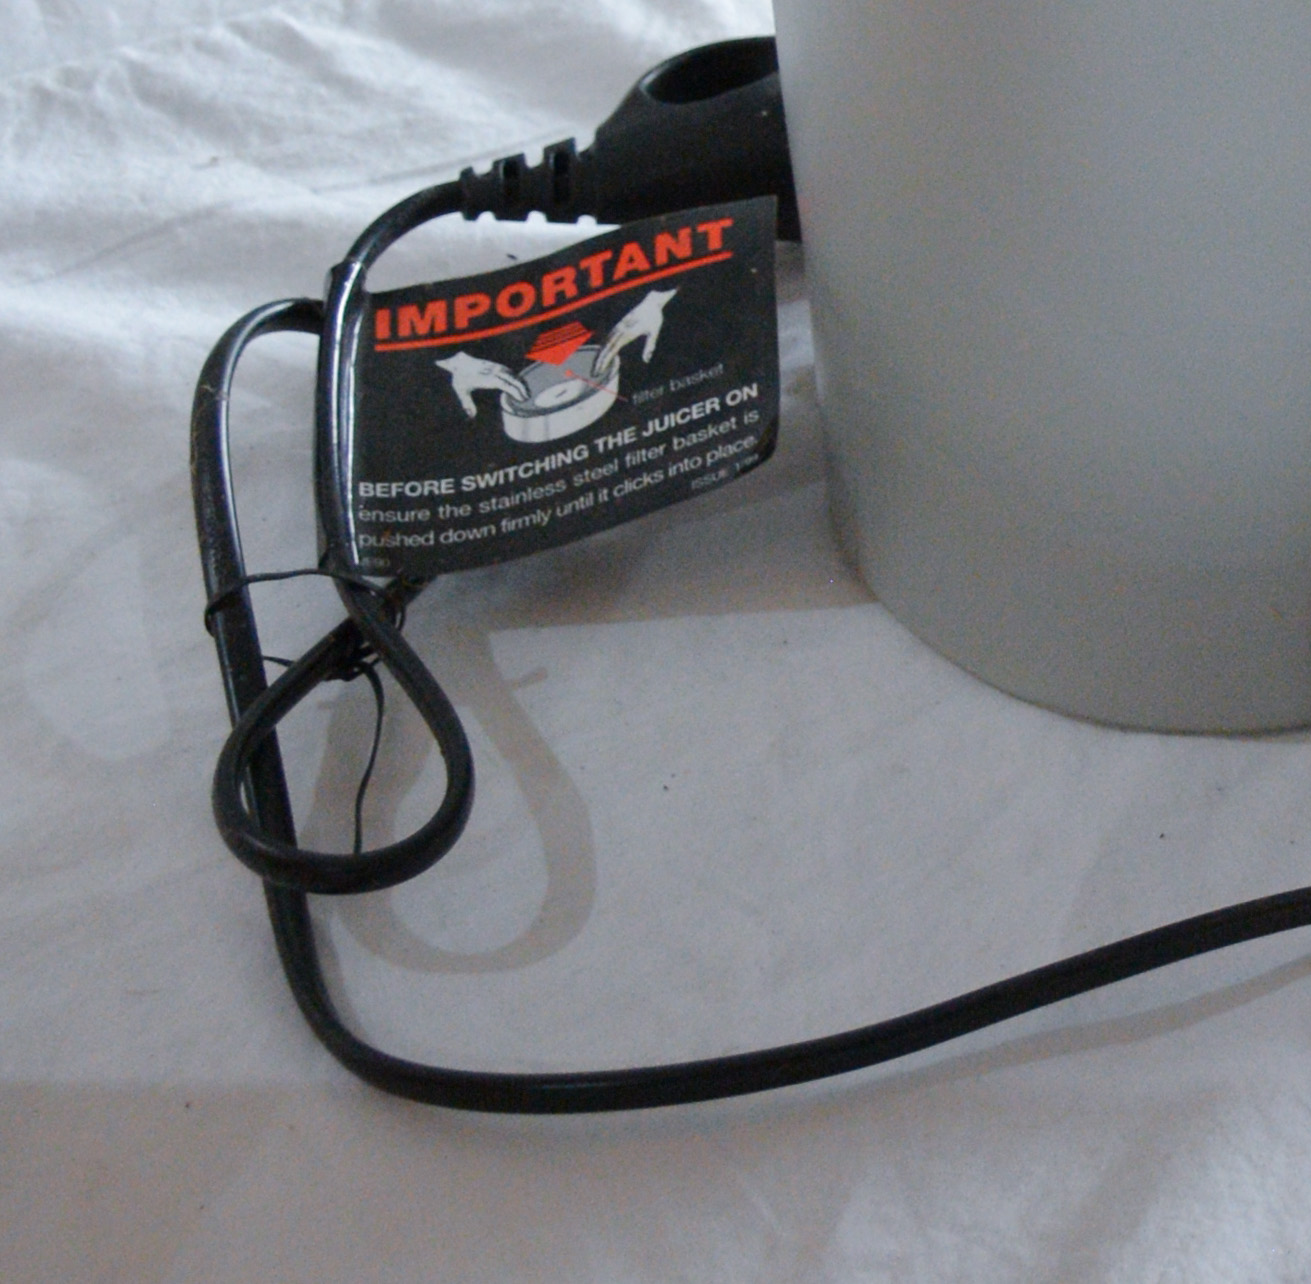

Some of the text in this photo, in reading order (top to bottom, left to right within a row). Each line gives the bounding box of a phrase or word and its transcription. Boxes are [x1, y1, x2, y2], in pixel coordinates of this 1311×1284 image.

[374, 218, 733, 340] IMPORTANT
[633, 363, 724, 405] filter basket
[358, 383, 759, 499] BEFORE SWITCHING THE JUICER ON
[358, 410, 760, 523] ensure the stainless steel filter basket is
[357, 531, 435, 549] pushed
[439, 523, 497, 544] down
[500, 507, 552, 539] firmly
[555, 491, 595, 518] until
[598, 487, 611, 503] it
[612, 468, 665, 498] clicks
[668, 456, 702, 477] into
